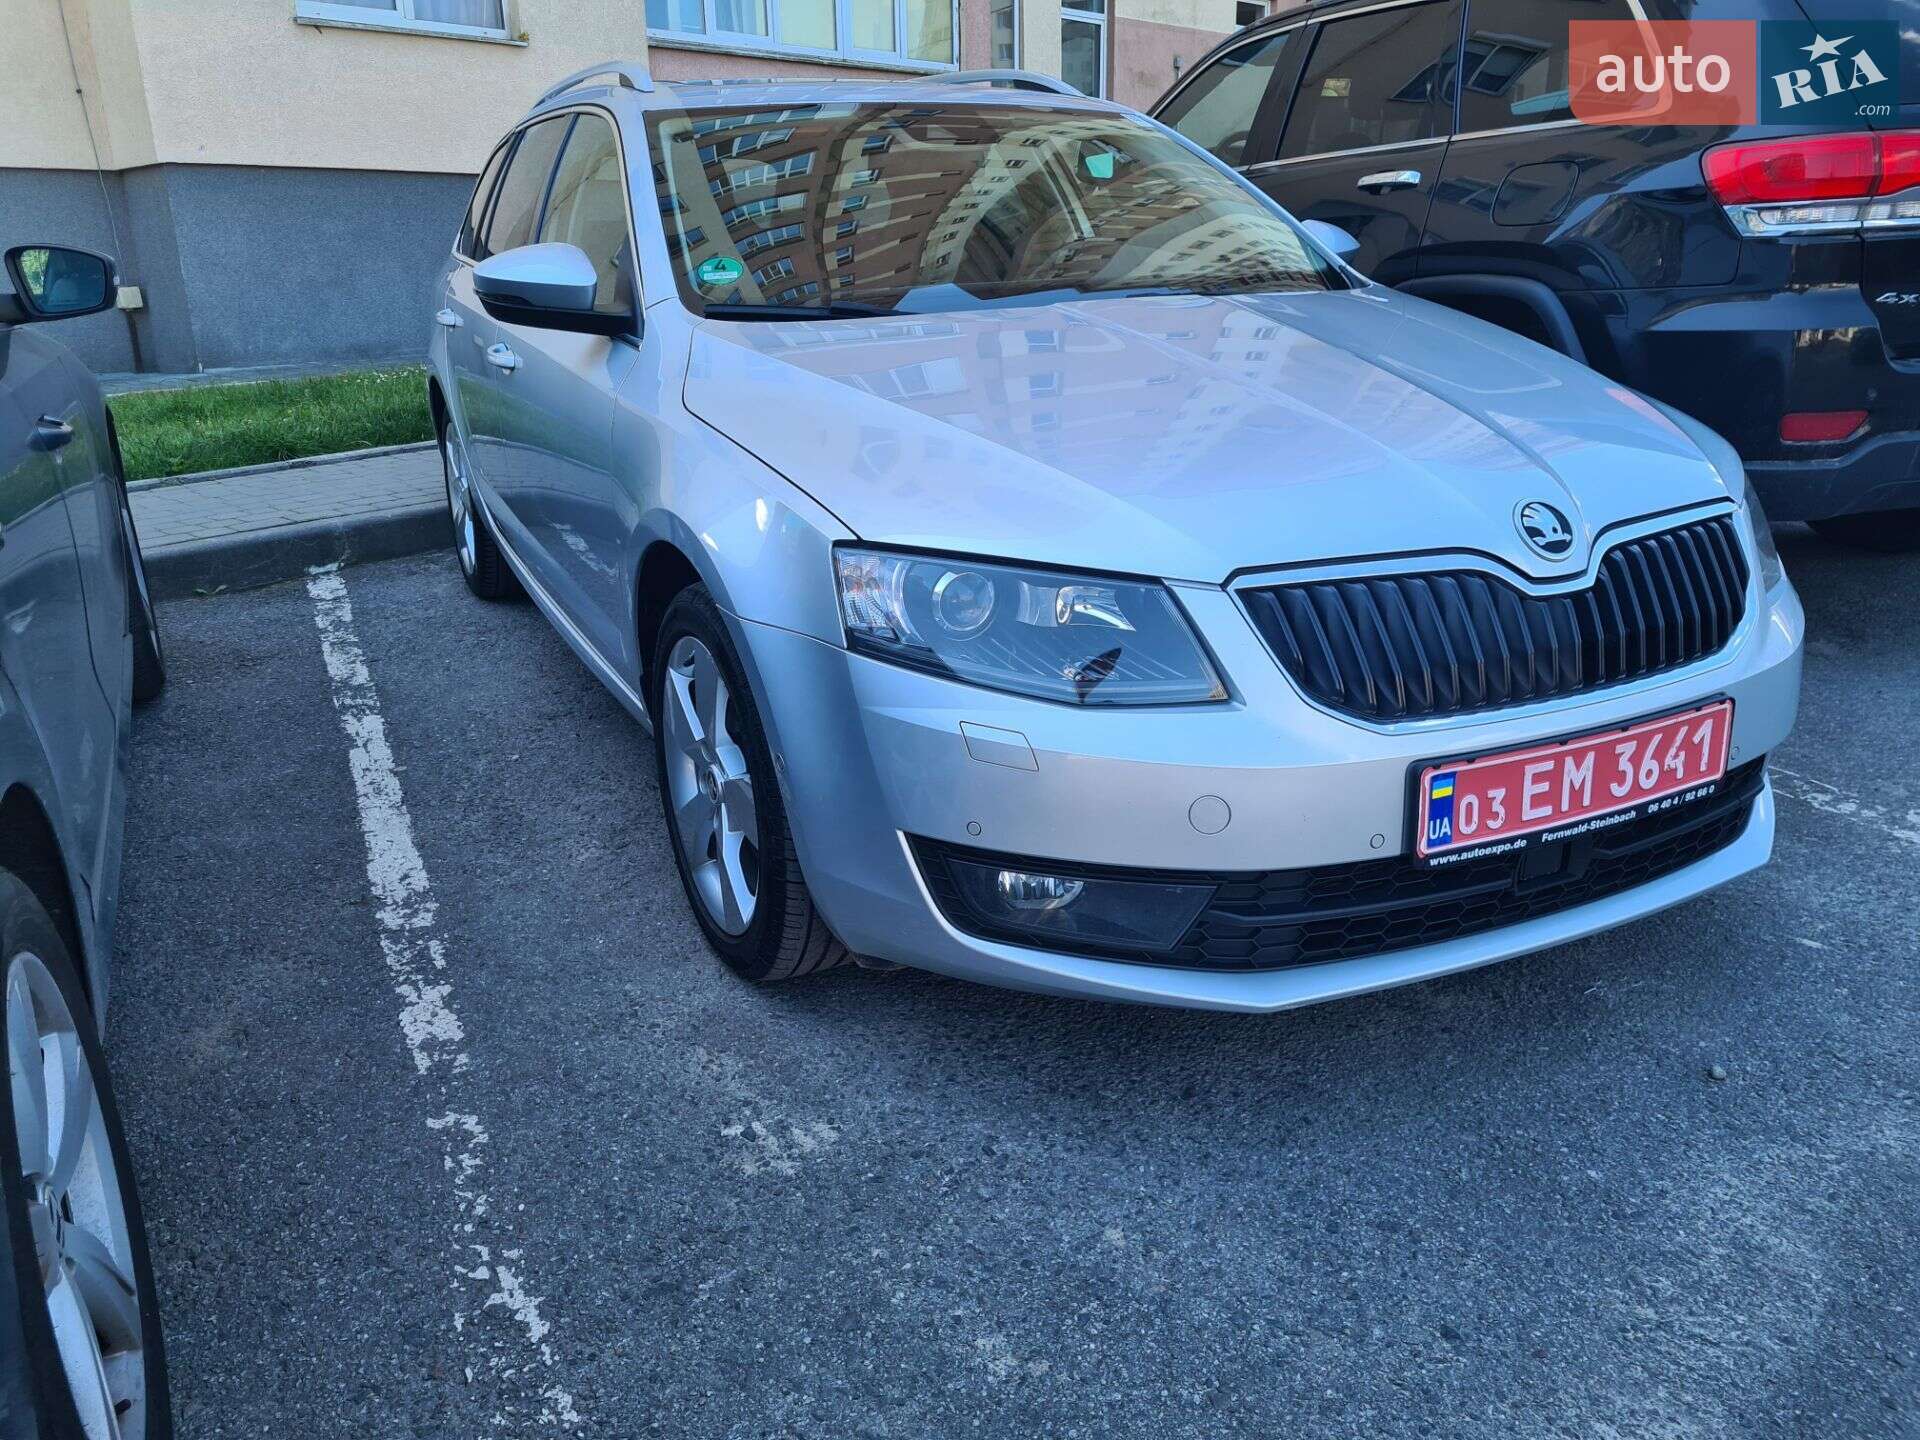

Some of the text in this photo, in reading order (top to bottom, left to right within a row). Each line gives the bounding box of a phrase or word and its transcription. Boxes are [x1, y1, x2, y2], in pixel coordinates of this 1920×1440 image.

[714, 259, 727, 271] 4
[1459, 718, 1714, 835] 03 EM 3641
[1429, 816, 1452, 840] UA
[1429, 838, 1528, 867] www.autoexpo.de
[1541, 809, 1637, 843] Fernwald-Steinbach
